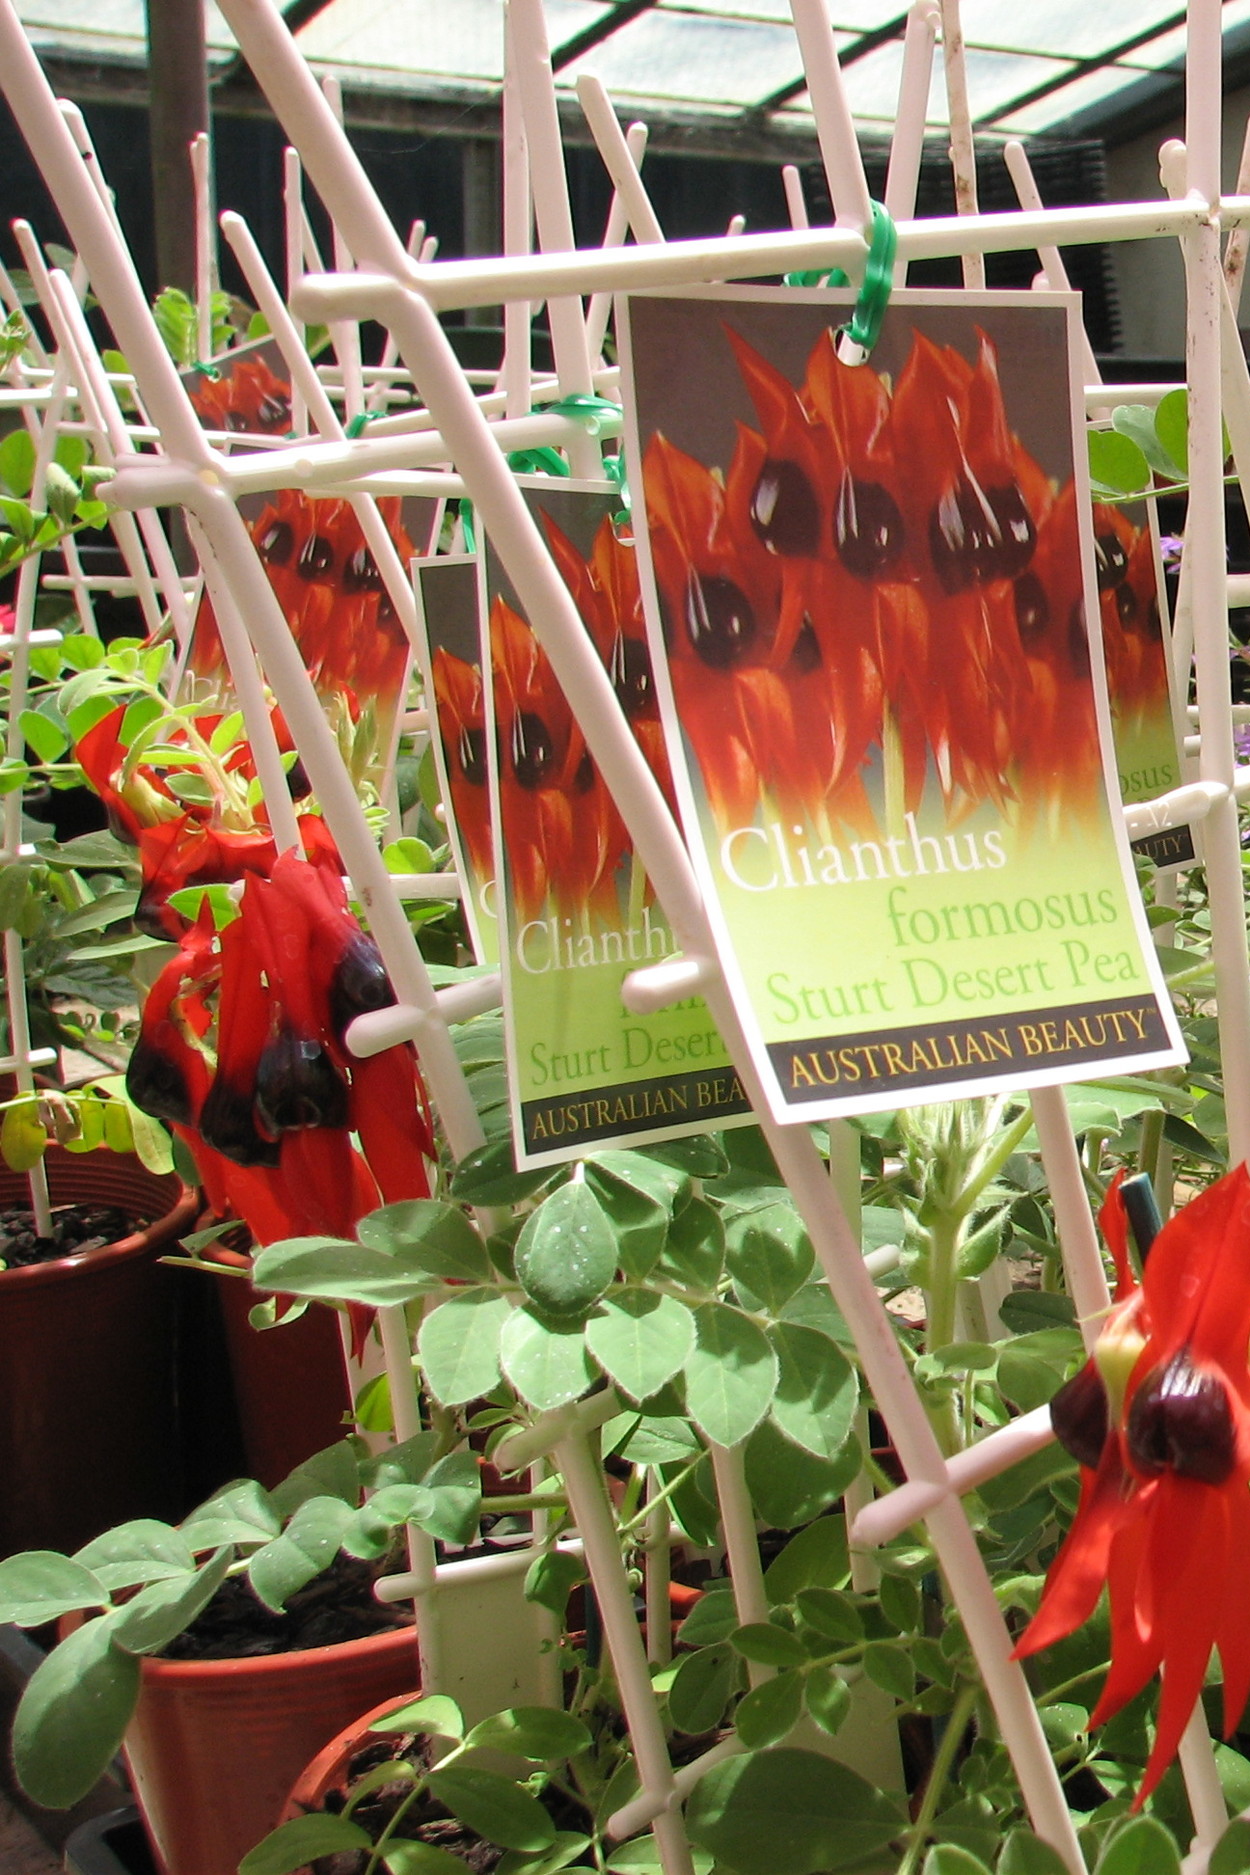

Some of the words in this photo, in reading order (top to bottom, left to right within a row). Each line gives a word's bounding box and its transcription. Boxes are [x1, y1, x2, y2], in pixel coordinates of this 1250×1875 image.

[720, 811, 1008, 892] Clianthus
[888, 886, 1118, 947] formosus
[766, 972, 895, 1025] Sturt
[901, 957, 1055, 1009] Desert
[1060, 939, 1141, 987] Pea
[529, 1041, 612, 1087] Sturt
[622, 1026, 728, 1070] Deser
[790, 1028, 1014, 1088] AUSTRALIAN
[531, 1085, 690, 1141] AUSTRALIAN
